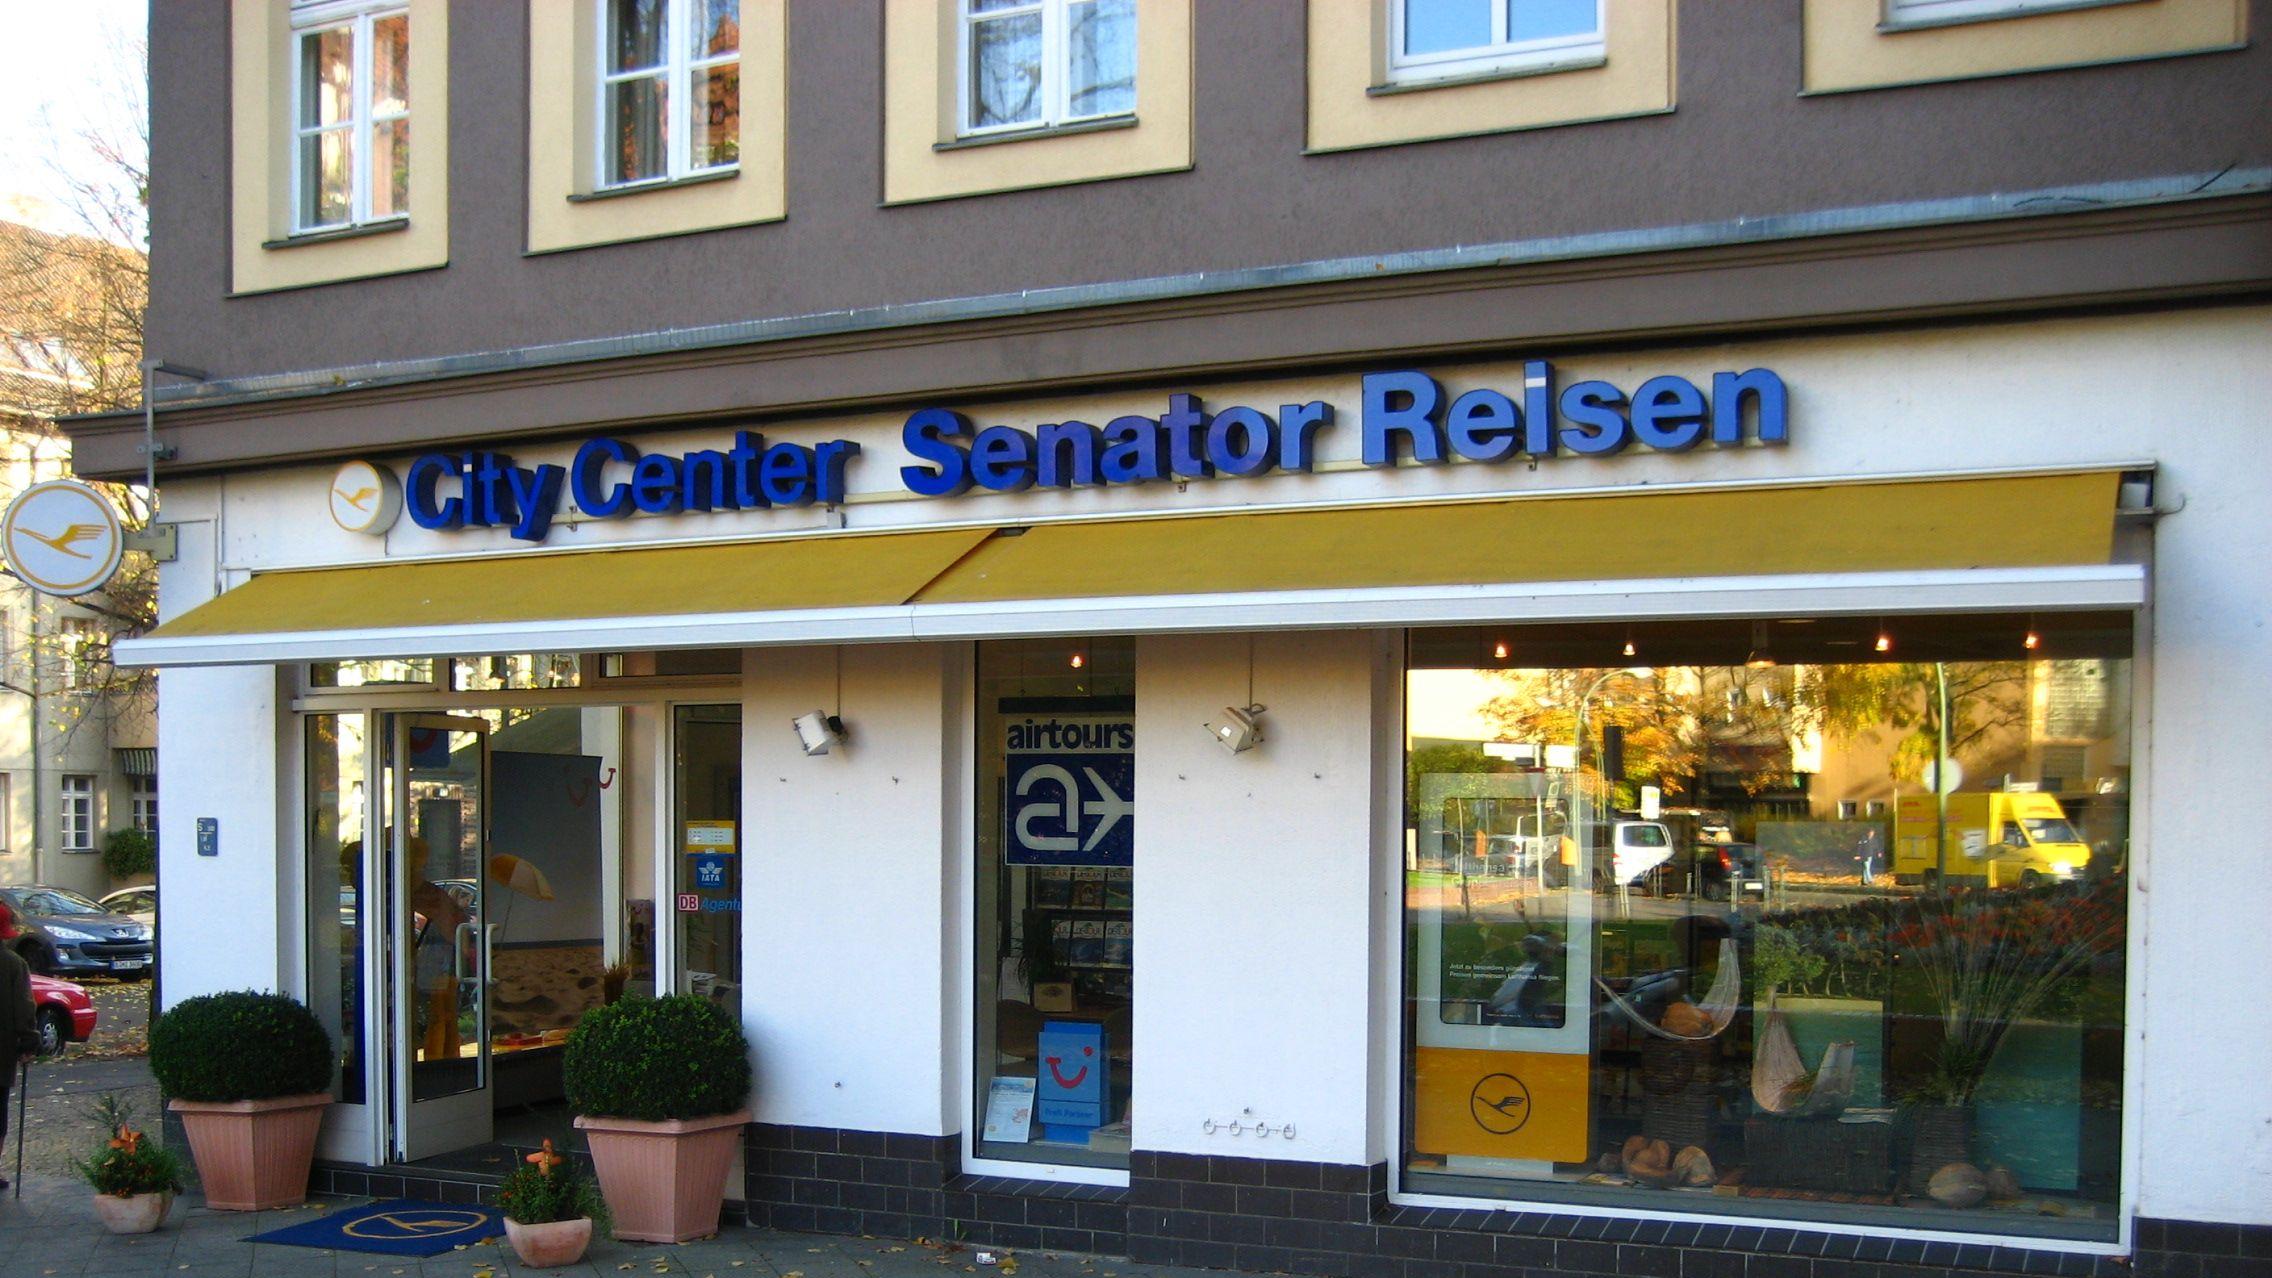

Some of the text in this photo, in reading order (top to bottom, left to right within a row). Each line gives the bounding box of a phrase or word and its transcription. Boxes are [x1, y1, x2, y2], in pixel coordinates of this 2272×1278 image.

[406, 359, 1789, 541] City Center Senator Reisen
[1007, 719, 1134, 750] airtours
[701, 874, 720, 882] IATA
[680, 896, 697, 910] DB
